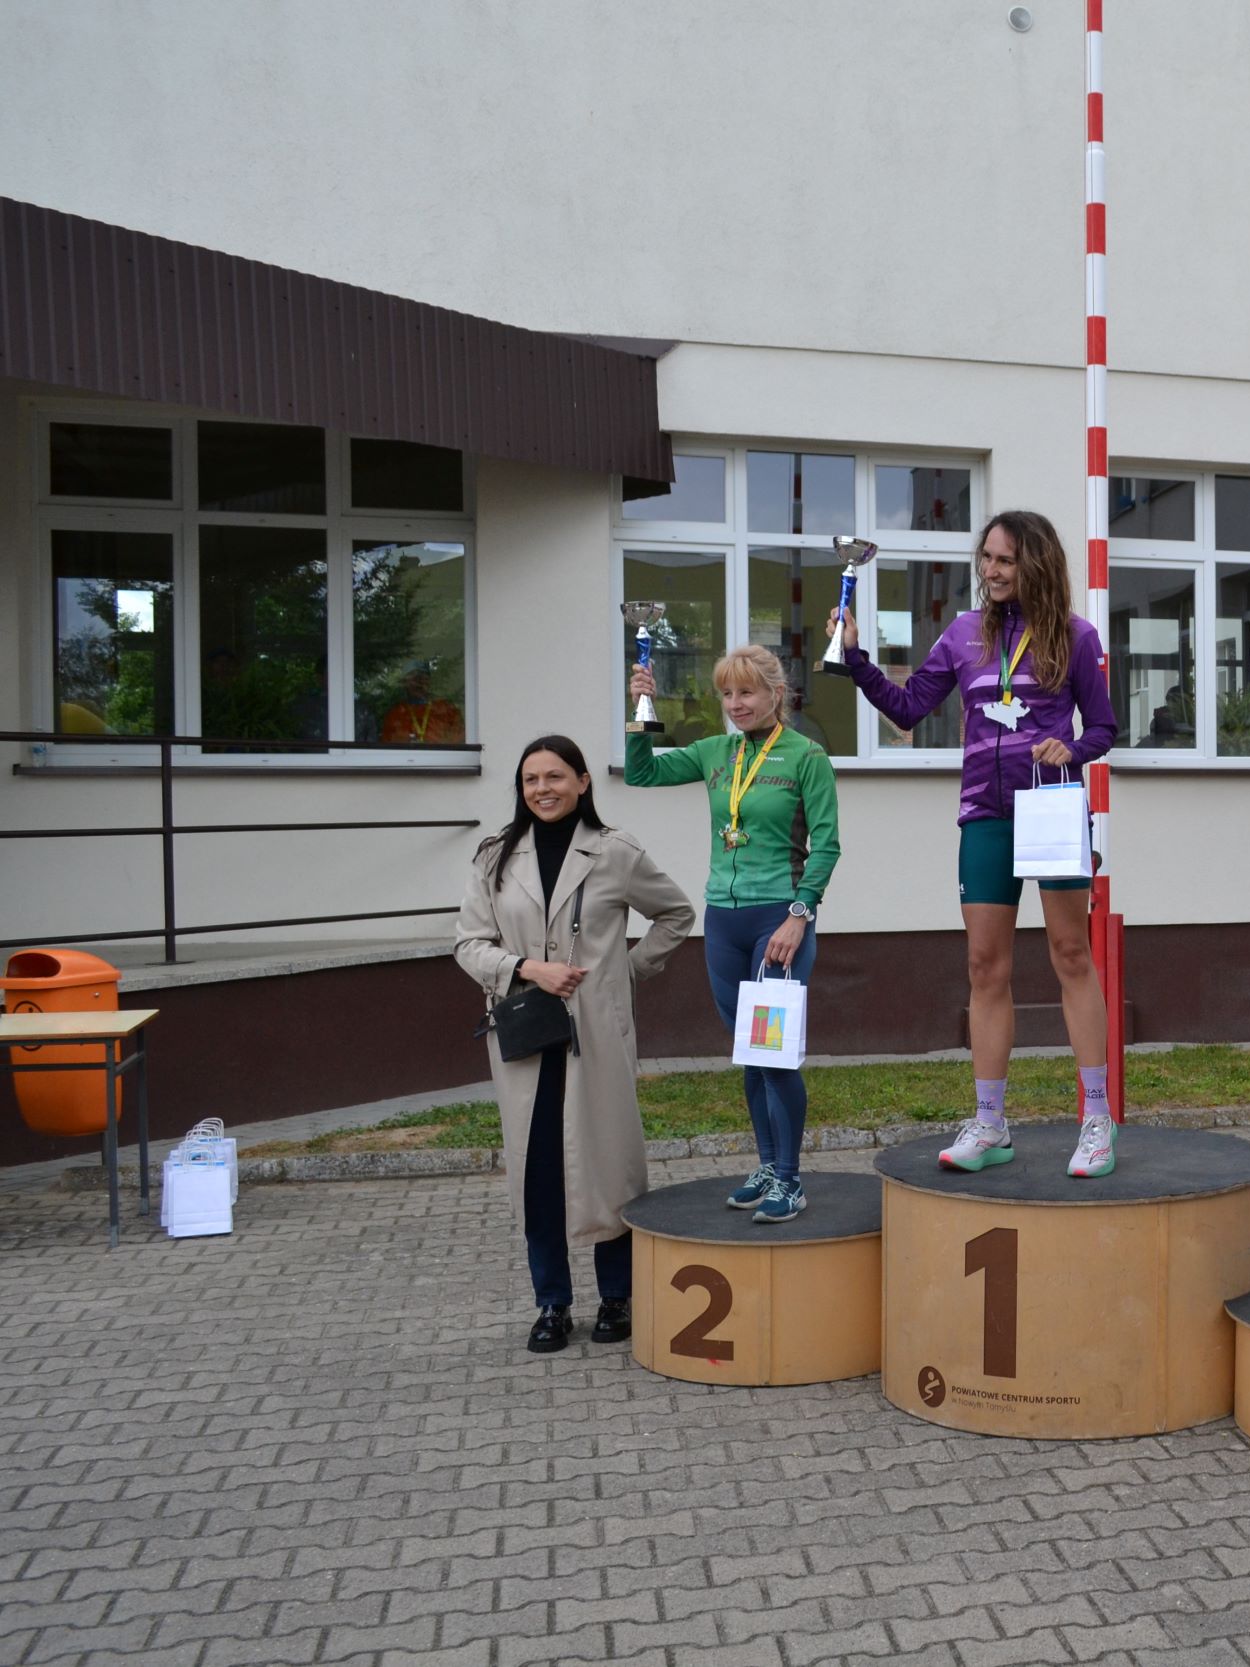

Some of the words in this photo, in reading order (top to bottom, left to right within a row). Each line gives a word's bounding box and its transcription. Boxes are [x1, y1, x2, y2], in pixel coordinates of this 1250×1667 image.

[669, 1264, 735, 1361] 2
[964, 1227, 1018, 1379] 1
[951, 1385, 1000, 1400] POWIATOWE
[1001, 1393, 1043, 1404] CENTRUM
[1045, 1396, 1081, 1405] SPORTU
